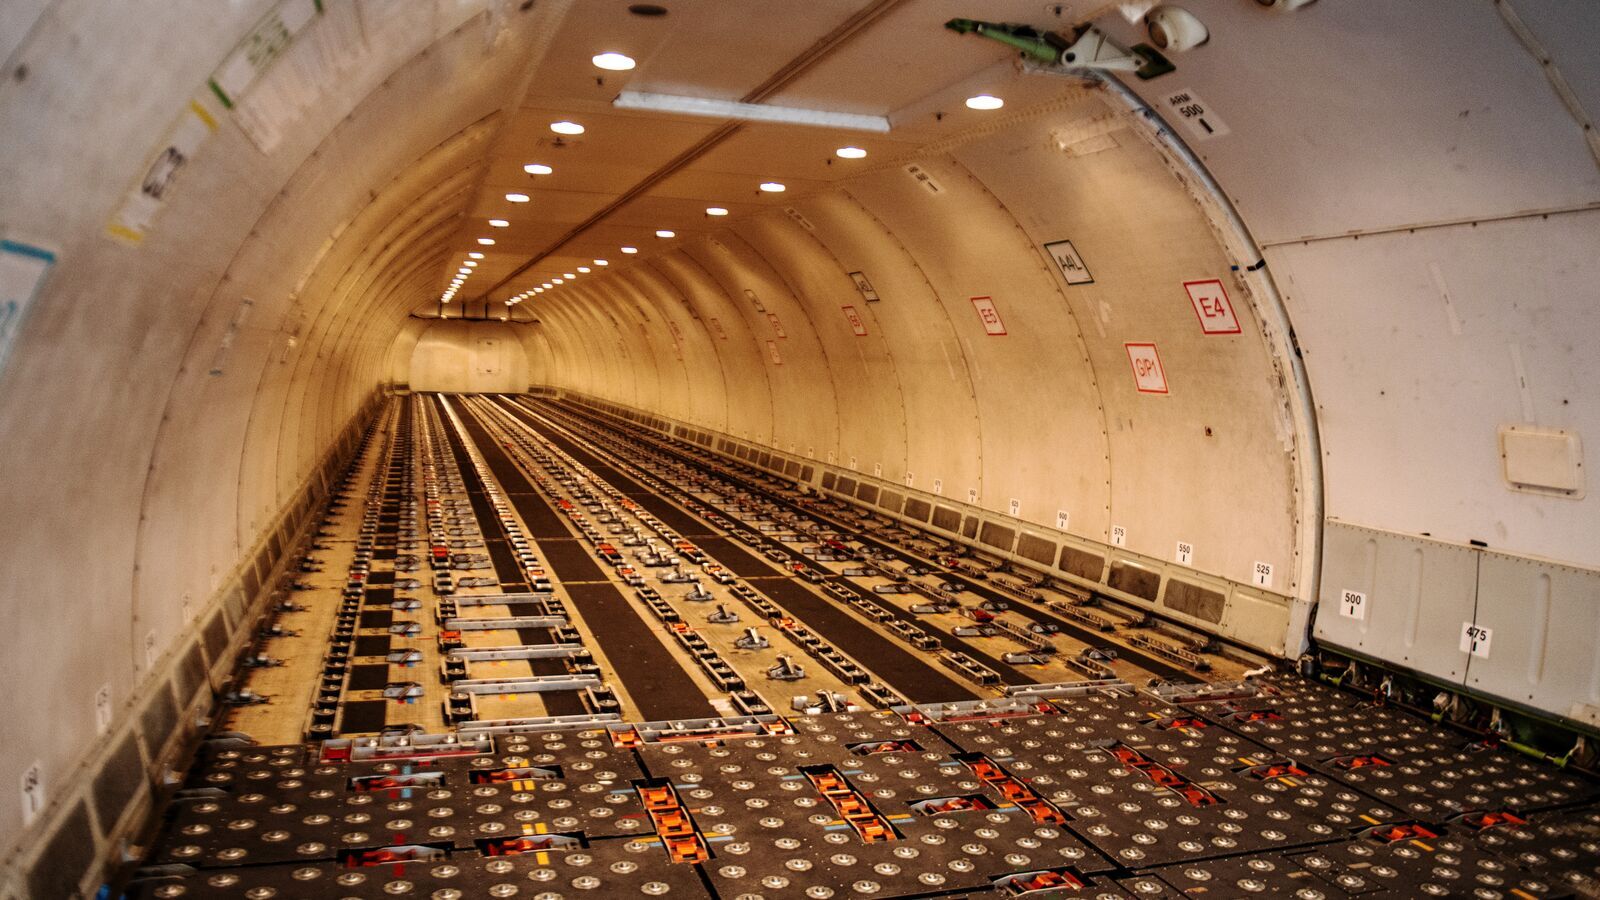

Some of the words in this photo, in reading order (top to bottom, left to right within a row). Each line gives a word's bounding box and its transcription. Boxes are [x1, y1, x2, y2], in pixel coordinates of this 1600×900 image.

[1169, 93, 1191, 106] ARM
[1180, 104, 1204, 117] 500
[1199, 296, 1225, 317] E4
[981, 308, 997, 323] E5
[1059, 512, 1067, 520] 600
[1114, 528, 1124, 537] 575
[1179, 543, 1191, 554] 550
[1256, 563, 1270, 575] 525
[1345, 592, 1361, 605] 500
[1466, 626, 1487, 641] 475
